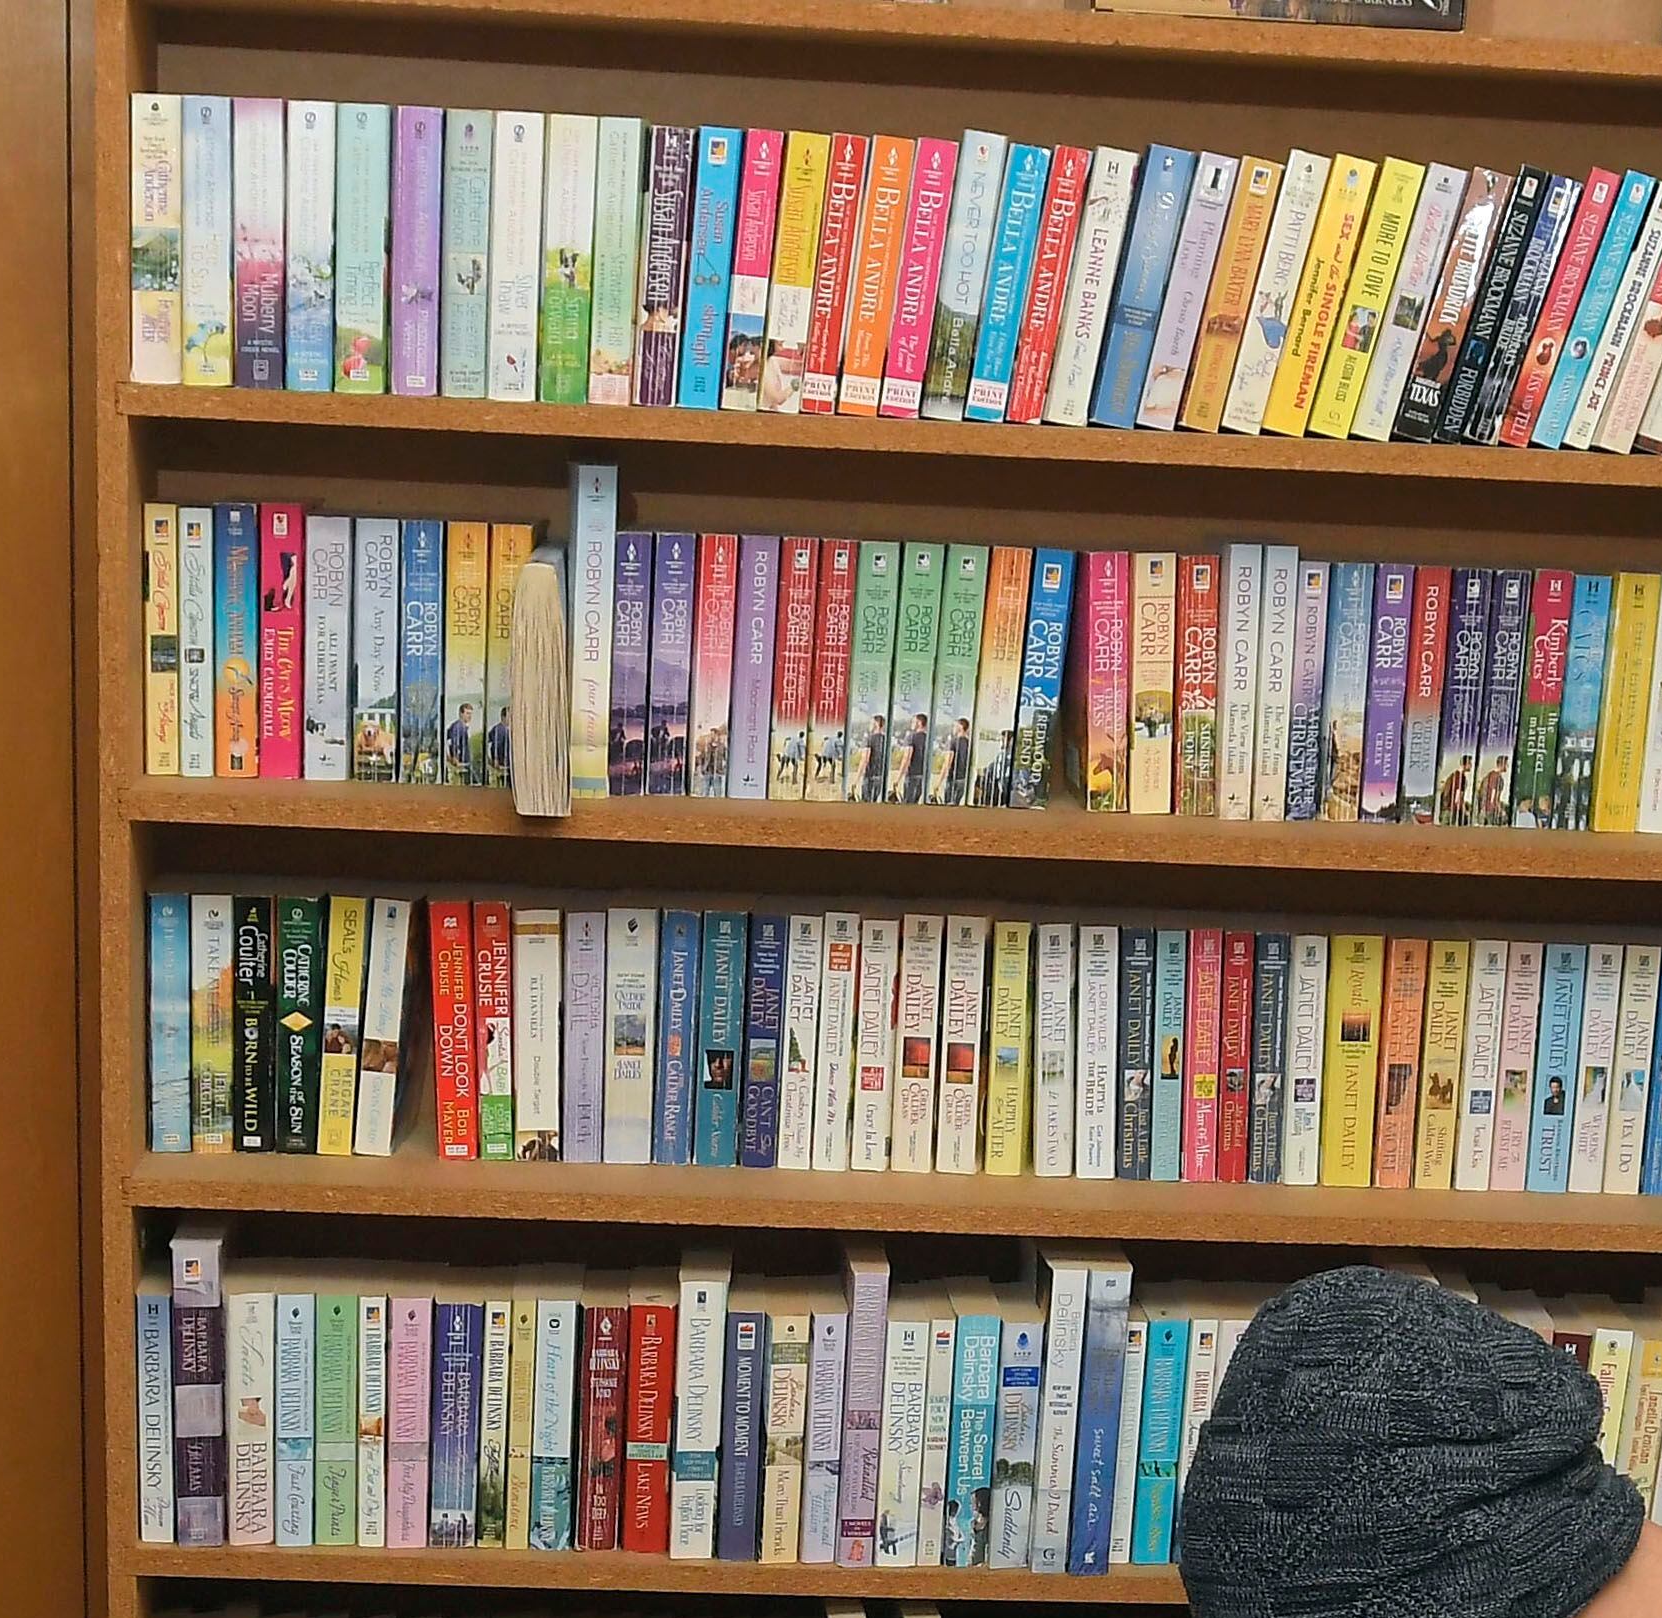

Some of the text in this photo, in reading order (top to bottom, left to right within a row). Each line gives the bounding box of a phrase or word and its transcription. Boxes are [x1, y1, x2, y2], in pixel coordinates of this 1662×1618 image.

[696, 187, 714, 258] Andersen
[713, 200, 729, 244] Susan
[860, 184, 901, 324] BELLA ANDRE
[901, 189, 944, 327] BELLA ANDRE
[1475, 211, 1528, 341] SUZANNE BROCKMANN
[241, 283, 258, 322] Moon
[262, 272, 280, 337] Mulberry
[1409, 380, 1441, 408] TEXAS
[1441, 364, 1478, 432] FORBIDDEN
[312, 548, 328, 601] CARR
[329, 540, 344, 608] ROBYN
[405, 601, 422, 657] CARR
[422, 602, 438, 658] ROBYN
[1547, 615, 1568, 691] Kimberly
[1288, 701, 1306, 807] CHRISTMAS
[236, 925, 255, 987] Coulter
[297, 943, 313, 1006] CATHERINE
[451, 941, 467, 999] JENNIFER
[491, 938, 509, 1016] JENNIFER
[1350, 968, 1366, 1007] Rivals
[904, 972, 920, 1033] DAILEY
[919, 983, 935, 1024] JANET
[948, 978, 964, 1038] DAILEY
[438, 1023, 454, 1079] DOWN
[453, 1049, 469, 1098] LOOK
[453, 1108, 470, 1140] BOB
[1050, 1293, 1073, 1370] Delinsky
[638, 1336, 657, 1444] BARBARA DELINSKY
[960, 1335, 977, 1405] Delinsky
[975, 1335, 996, 1400] Barbara
[142, 1329, 163, 1487] BARBARA DELINSKY
[956, 1410, 974, 1496] Between Us
[235, 1443, 253, 1533] DELINSKY
[999, 1488, 1019, 1559] Suddenly
